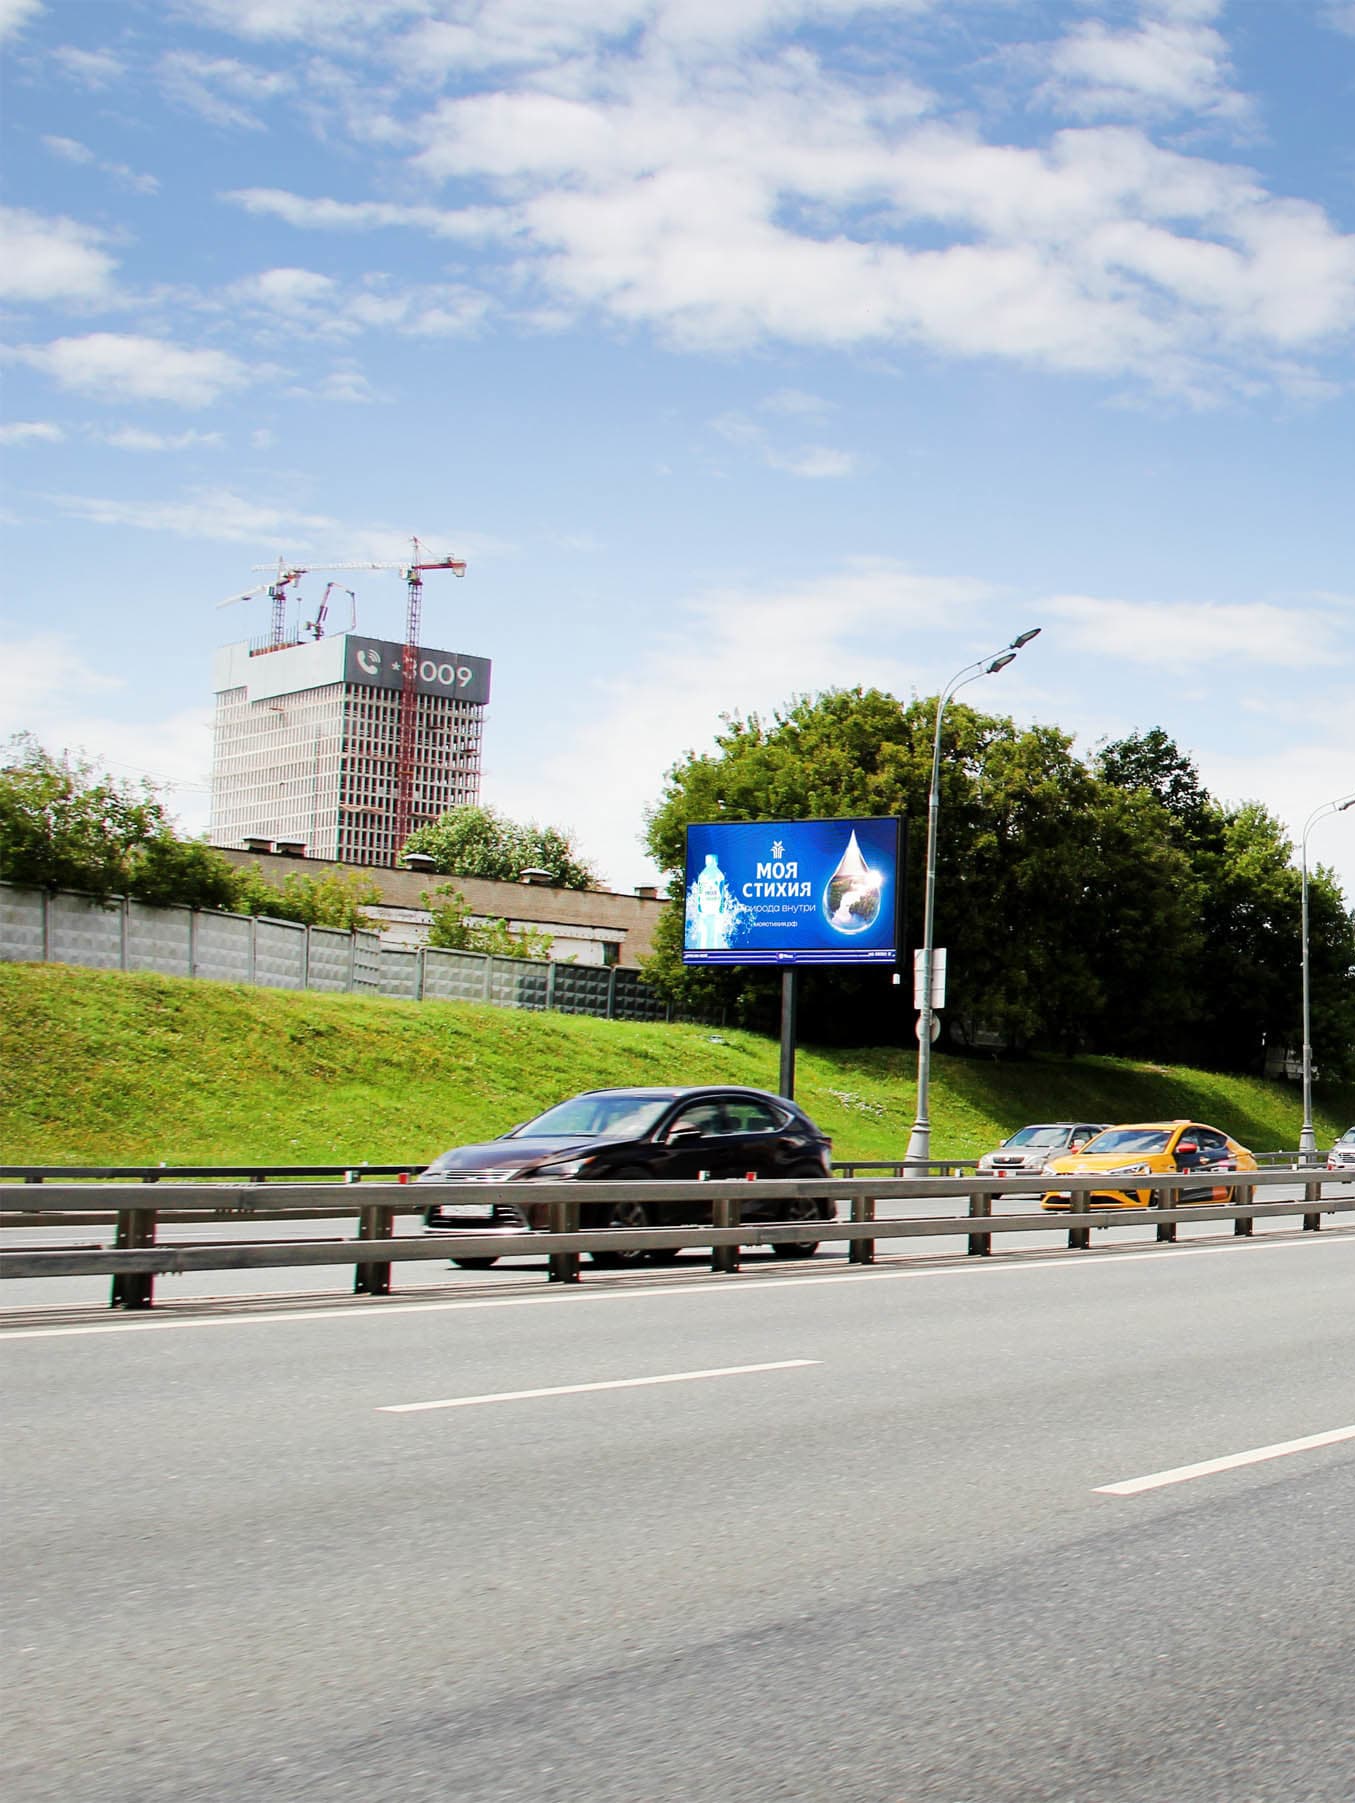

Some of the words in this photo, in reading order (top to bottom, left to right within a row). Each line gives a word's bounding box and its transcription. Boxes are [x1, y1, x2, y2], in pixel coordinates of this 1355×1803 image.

[756, 862, 798, 879] МОЯ
[742, 882, 812, 898] СТИХИЯ
[782, 903, 816, 914] внутри
